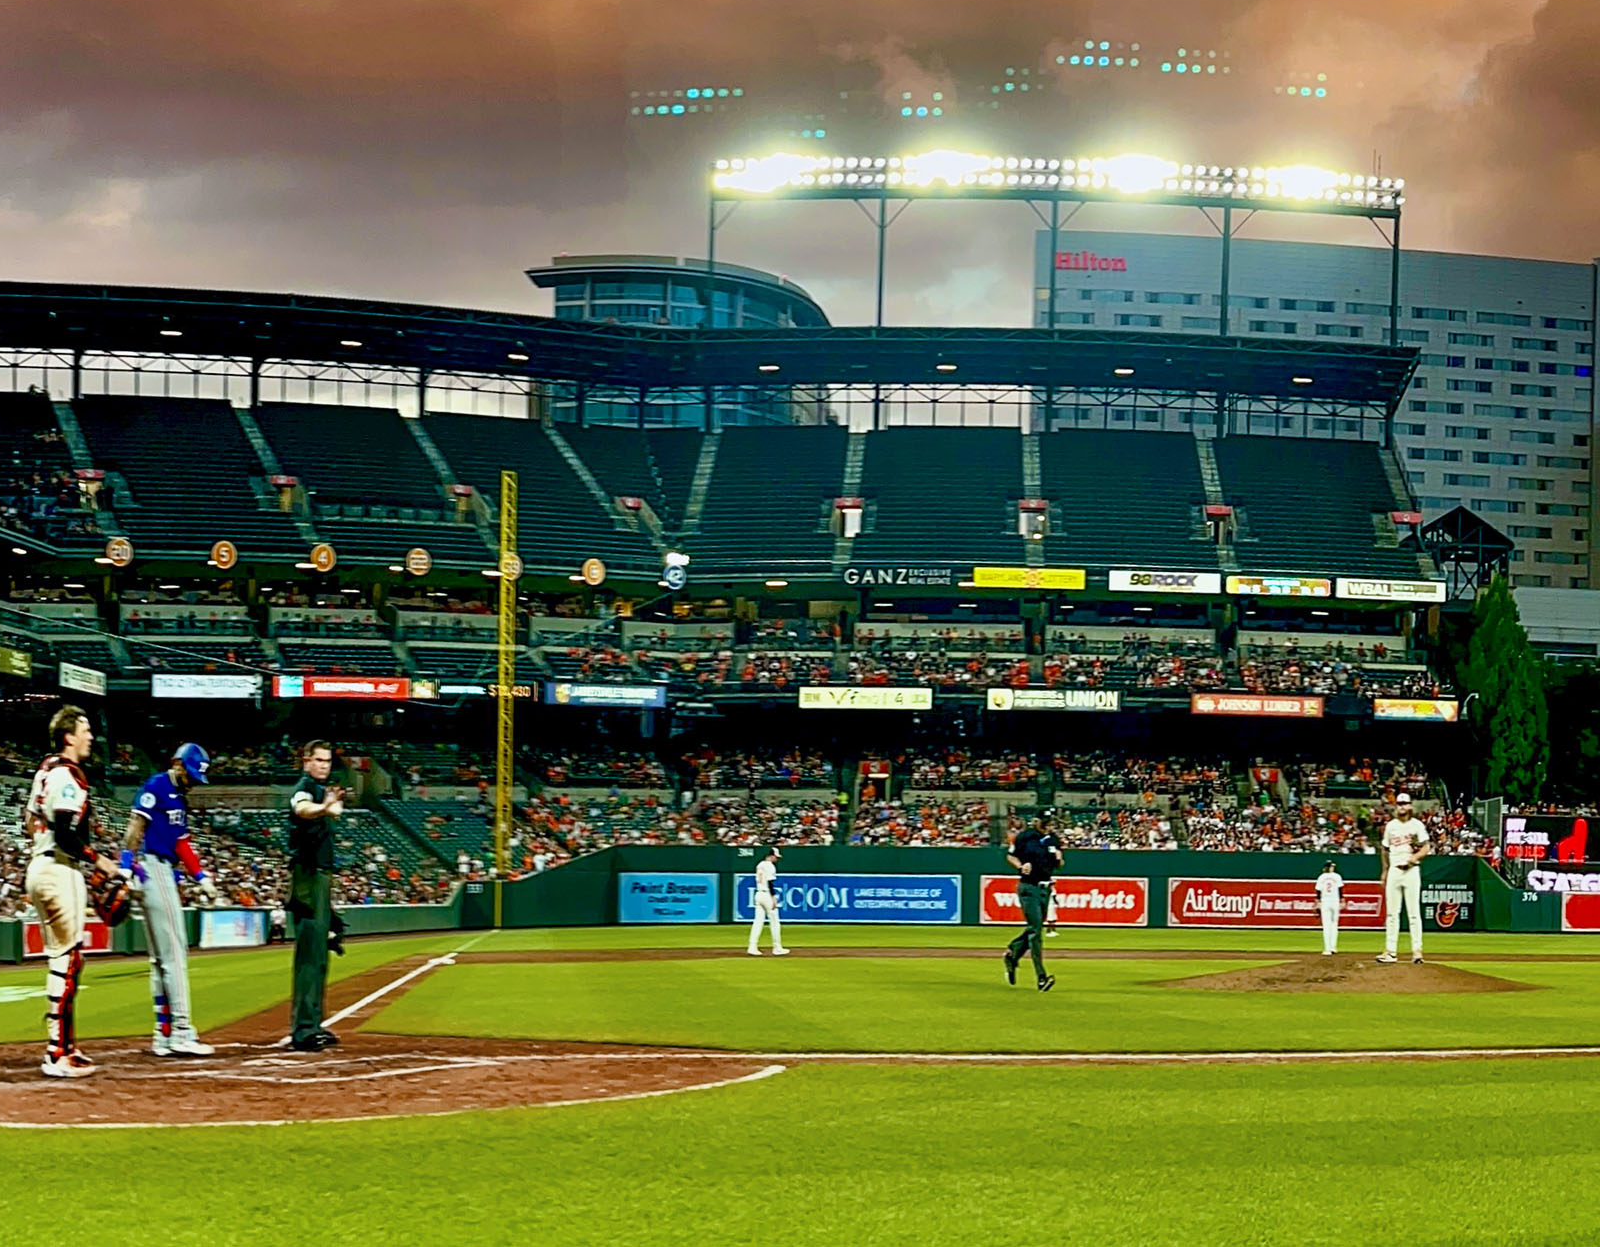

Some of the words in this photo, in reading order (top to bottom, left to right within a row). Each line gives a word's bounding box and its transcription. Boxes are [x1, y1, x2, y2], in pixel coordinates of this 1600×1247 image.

[1055, 251, 1127, 272] Hilton
[219, 546, 230, 562] 5
[317, 550, 328, 565] 4
[844, 568, 908, 585] GANZ
[1349, 582, 1391, 596] WBAL
[1066, 691, 1118, 709] UNION
[1217, 699, 1262, 712] JOHNSON
[666, 882, 708, 895] Breeze
[855, 888, 876, 897] LAKE
[877, 888, 893, 897] ERIE
[894, 888, 927, 897] COLLEGE
[929, 888, 942, 897] OF
[1182, 887, 1252, 918] Airtemp
[1259, 899, 1273, 910] The
[1274, 899, 1293, 910] Best
[1421, 890, 1474, 904] CHAMPIONS
[1522, 891, 1538, 902] 376
